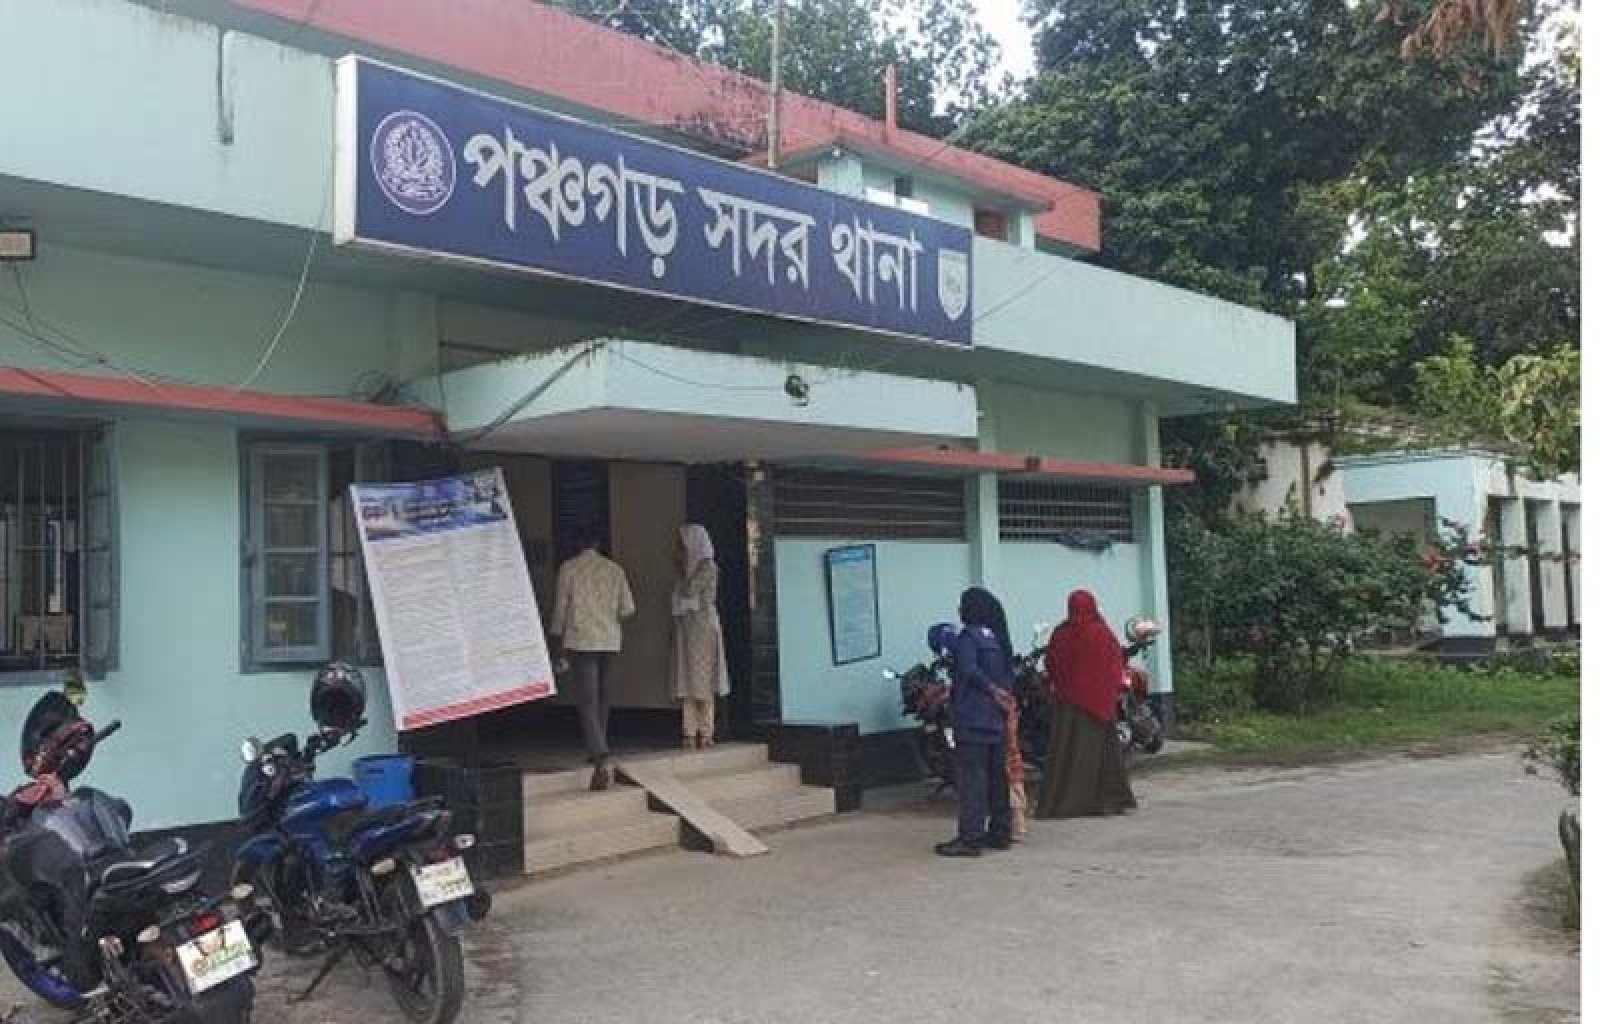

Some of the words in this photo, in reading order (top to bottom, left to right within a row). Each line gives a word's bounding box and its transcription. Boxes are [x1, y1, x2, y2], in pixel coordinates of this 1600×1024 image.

[464, 127, 684, 279] পঞ্চগড়
[699, 186, 816, 290] সদর
[830, 215, 924, 312] থানা
